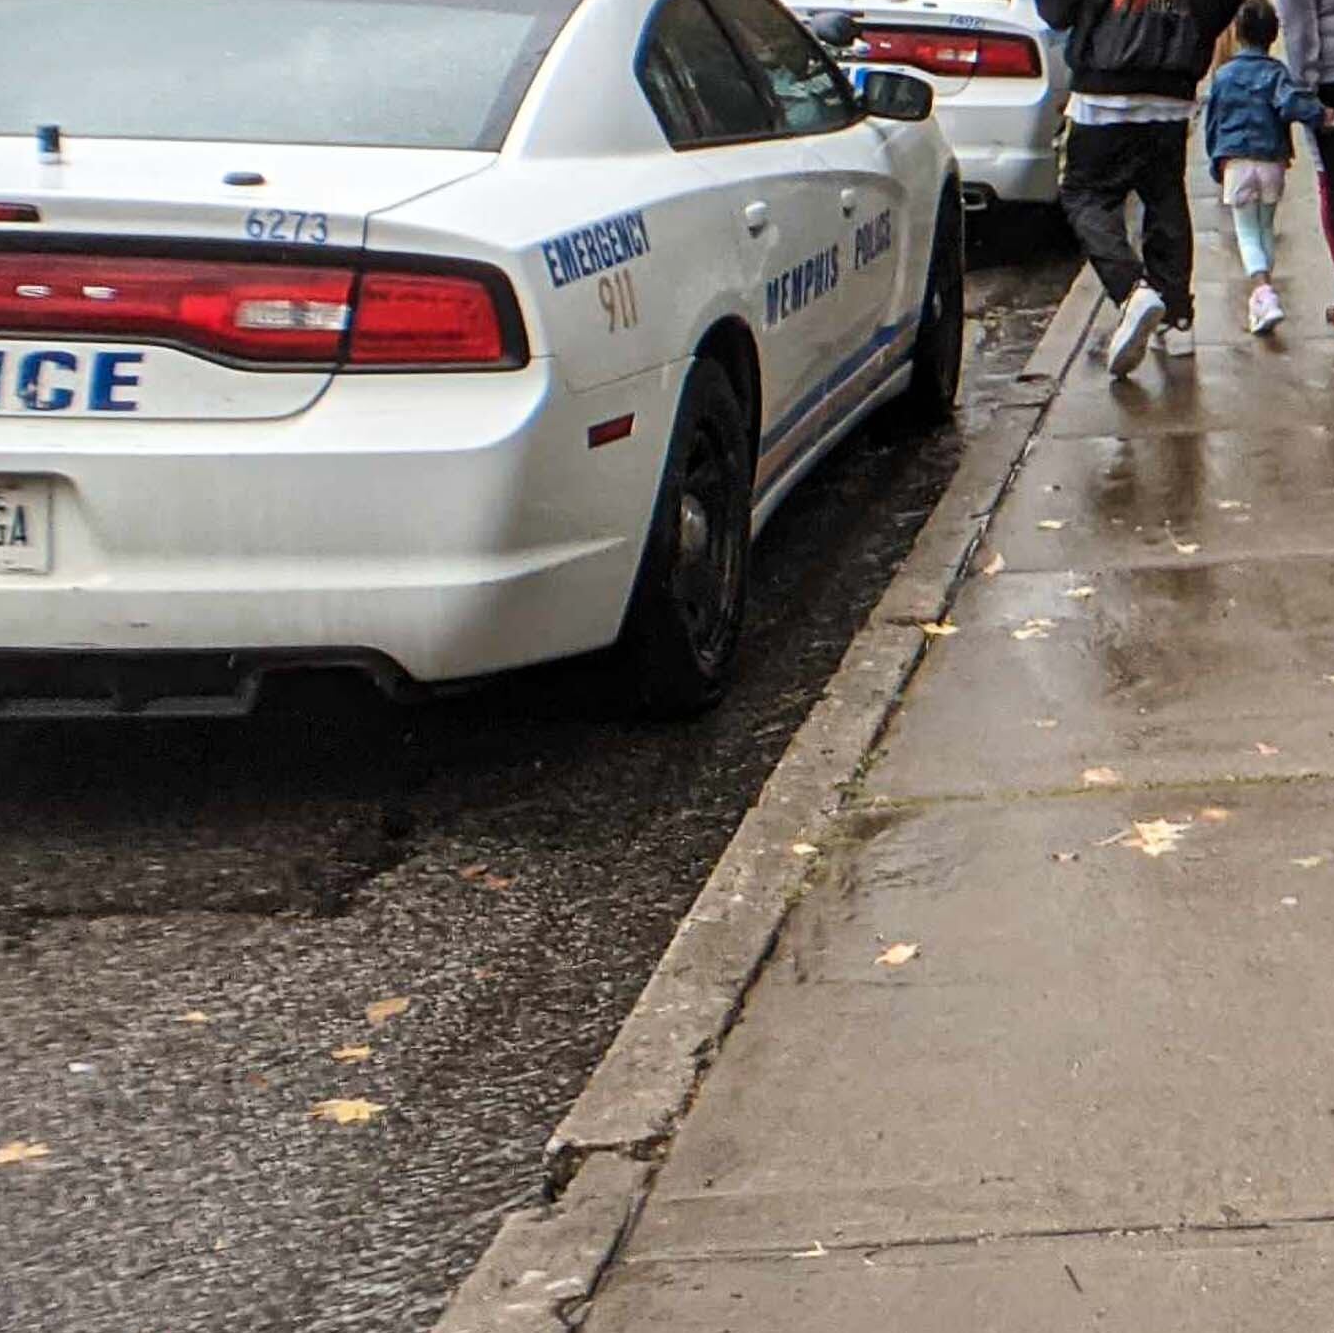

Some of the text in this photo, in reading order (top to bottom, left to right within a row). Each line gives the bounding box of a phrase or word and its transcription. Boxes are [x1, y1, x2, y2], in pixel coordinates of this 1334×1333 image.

[245, 208, 329, 244] 6273
[541, 209, 651, 288] EMERGENCY
[598, 268, 638, 334] 911
[765, 240, 839, 327] MEMPHIS
